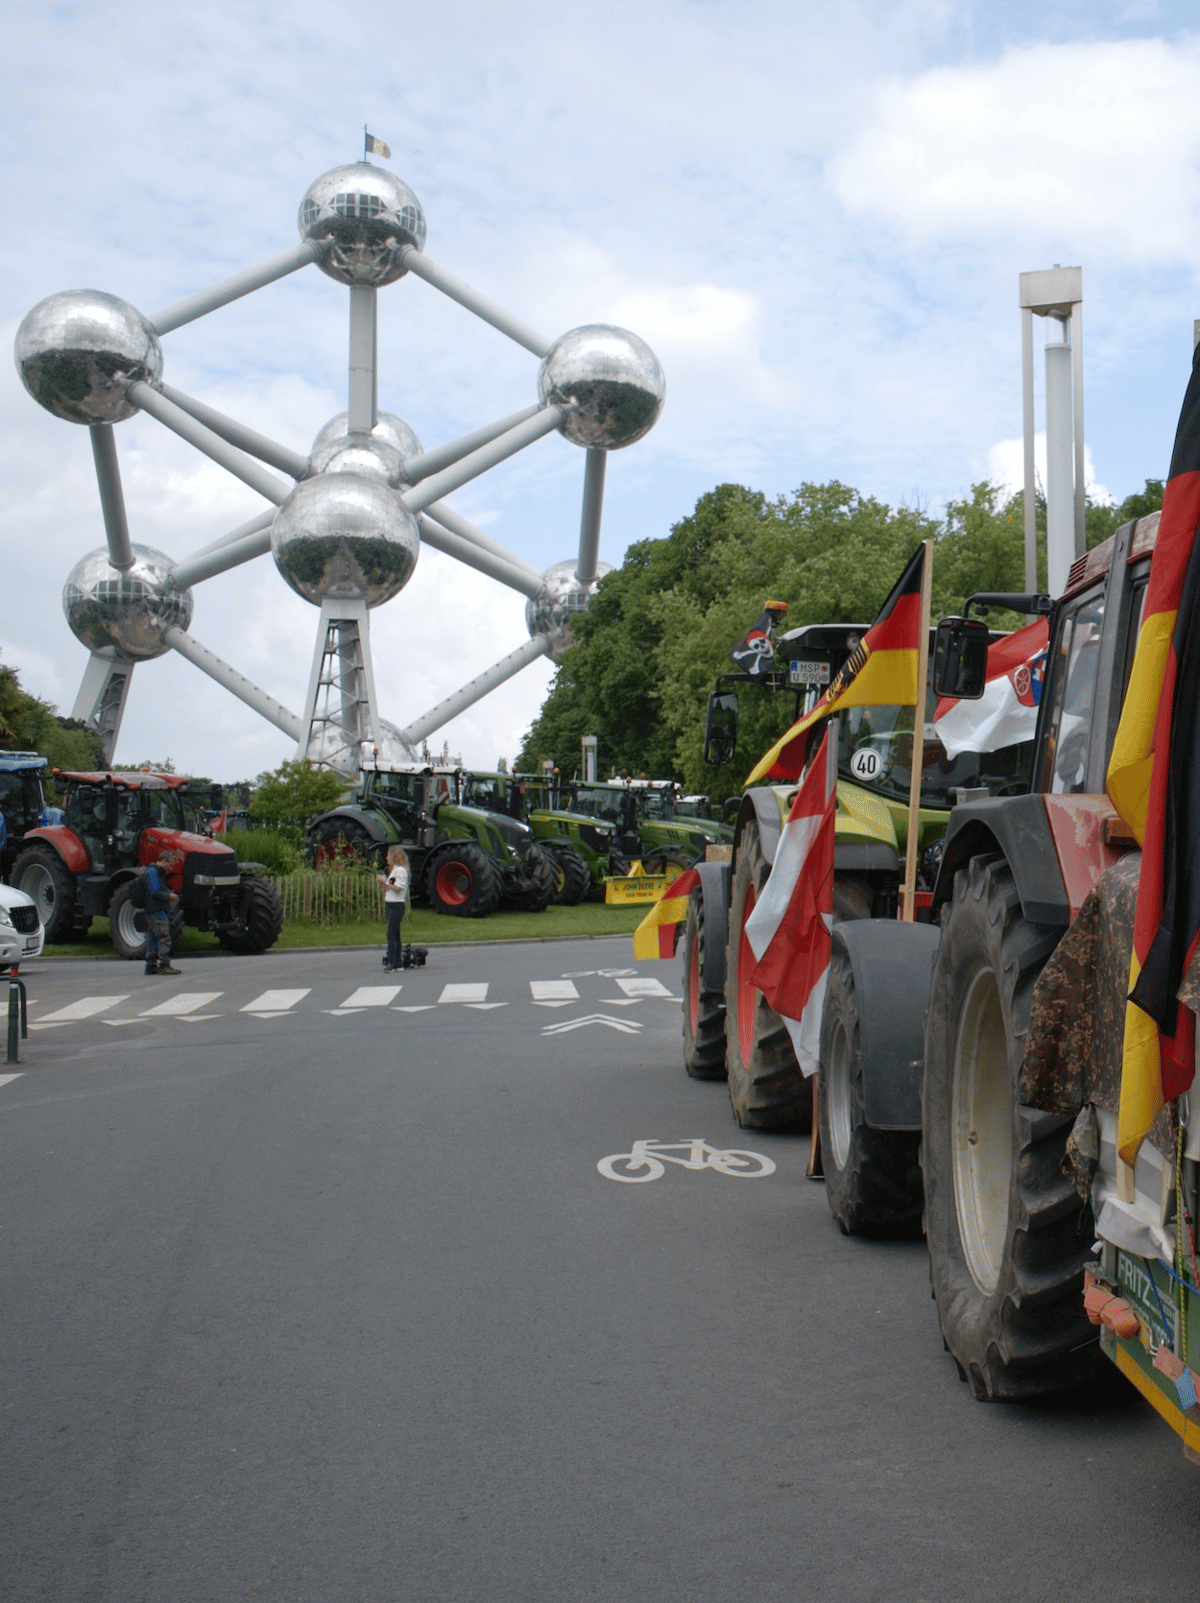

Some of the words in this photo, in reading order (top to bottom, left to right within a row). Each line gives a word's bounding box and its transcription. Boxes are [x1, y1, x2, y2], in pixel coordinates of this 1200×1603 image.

[800, 663, 820, 673] MSP
[856, 754, 877, 774] 40
[1118, 1251, 1151, 1307] FRITZ
